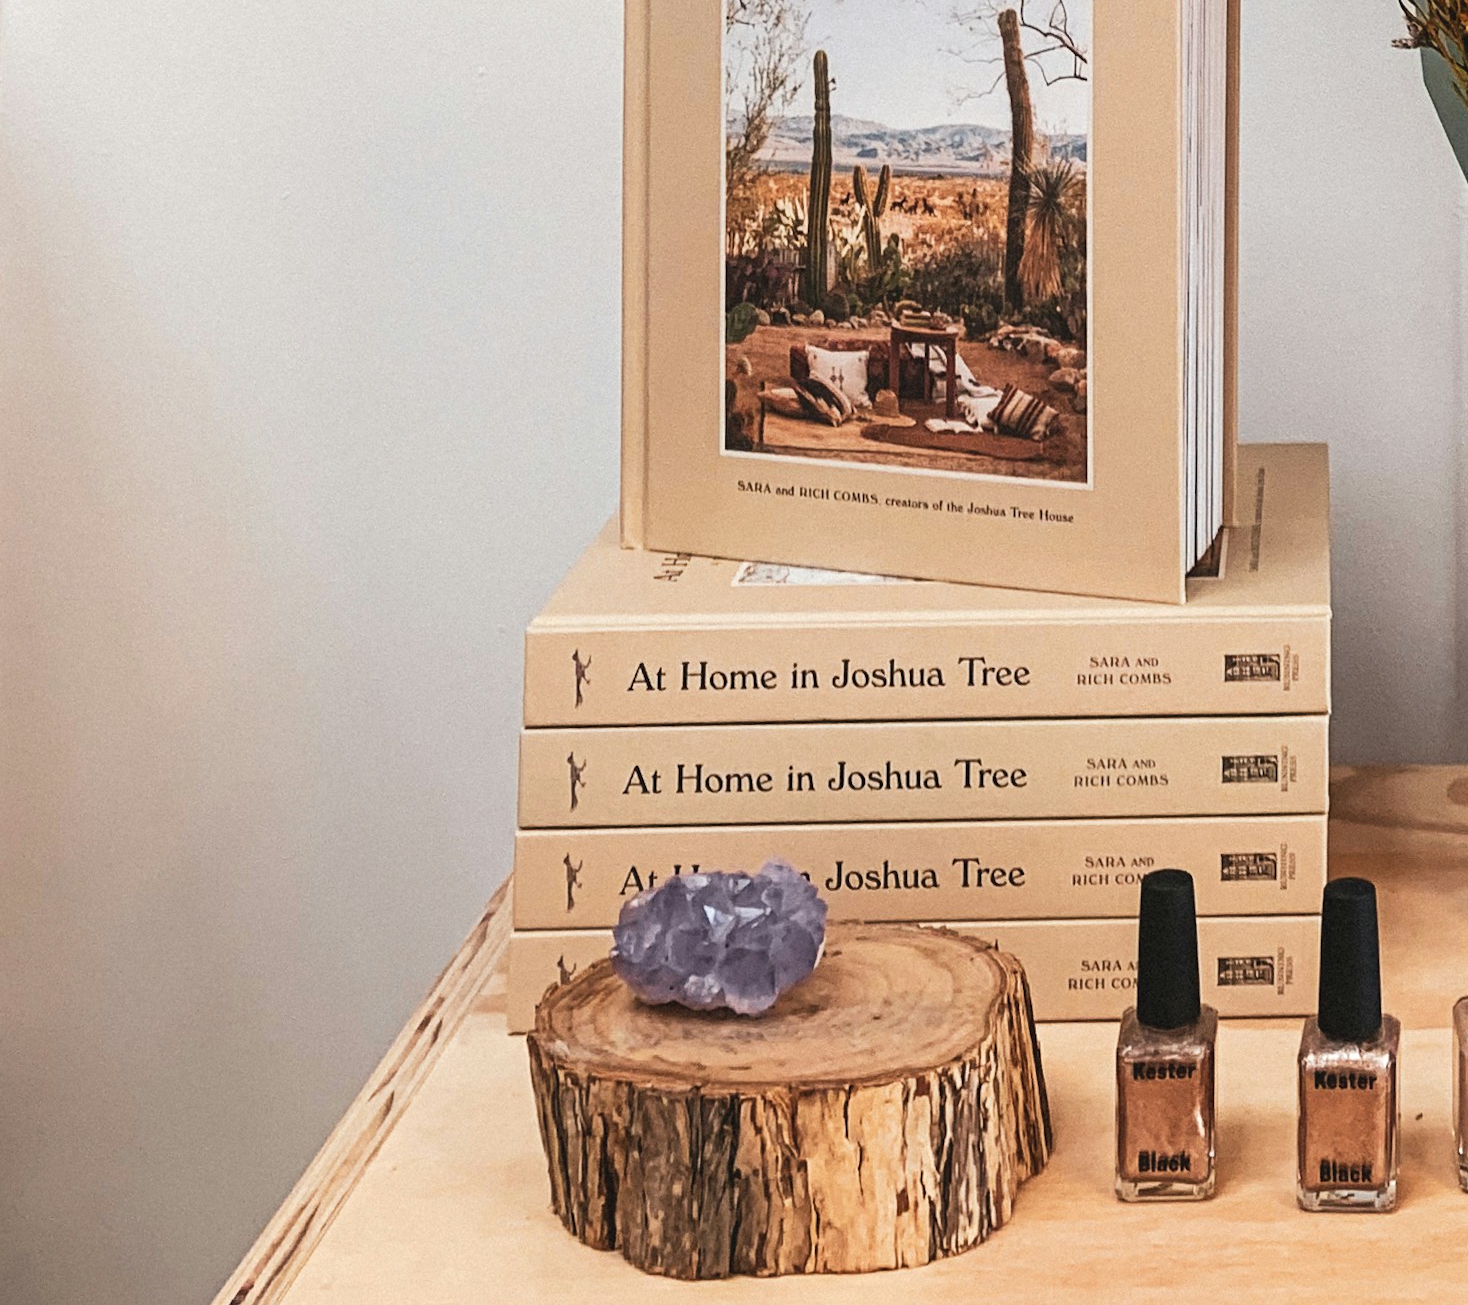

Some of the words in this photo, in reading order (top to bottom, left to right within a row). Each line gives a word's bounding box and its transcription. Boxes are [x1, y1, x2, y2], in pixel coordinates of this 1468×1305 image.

[737, 480, 771, 494] SARA
[776, 486, 795, 498] and
[799, 487, 830, 500] RICH
[885, 497, 929, 511] creators
[933, 499, 943, 511] of
[947, 500, 963, 513] the
[967, 501, 1006, 518] Joshua
[1010, 506, 1035, 520] Tree
[1039, 509, 1075, 524] House
[1089, 656, 1130, 669] SARA
[1135, 657, 1159, 667] AND
[628, 662, 666, 691] At
[681, 661, 777, 690] Home
[791, 663, 819, 689] in
[832, 659, 946, 689] Joshua
[958, 656, 1031, 686] Tree
[1077, 673, 1114, 686] RICH
[1120, 673, 1172, 685] COMBS
[1086, 758, 1127, 771] SARA
[1132, 759, 1156, 769] AND
[622, 765, 661, 794] At
[676, 764, 773, 793] Home
[787, 766, 815, 791] in
[828, 761, 942, 791] Joshua
[954, 759, 1027, 789] Tree
[1074, 775, 1110, 787] RICH
[1116, 774, 1169, 786] COMBS
[1085, 856, 1126, 868] SARA
[1131, 857, 1154, 867] AND
[619, 865, 658, 895] At
[825, 861, 939, 891] Joshua
[952, 858, 1026, 888] Tree
[1072, 873, 1109, 886] RICH
[1081, 960, 1121, 972] SARA
[1068, 977, 1105, 990] RICH
[1132, 1062, 1197, 1080] Kester
[1314, 1070, 1377, 1090] Kester
[1138, 1150, 1191, 1173] Black
[1319, 1159, 1373, 1183] Black
